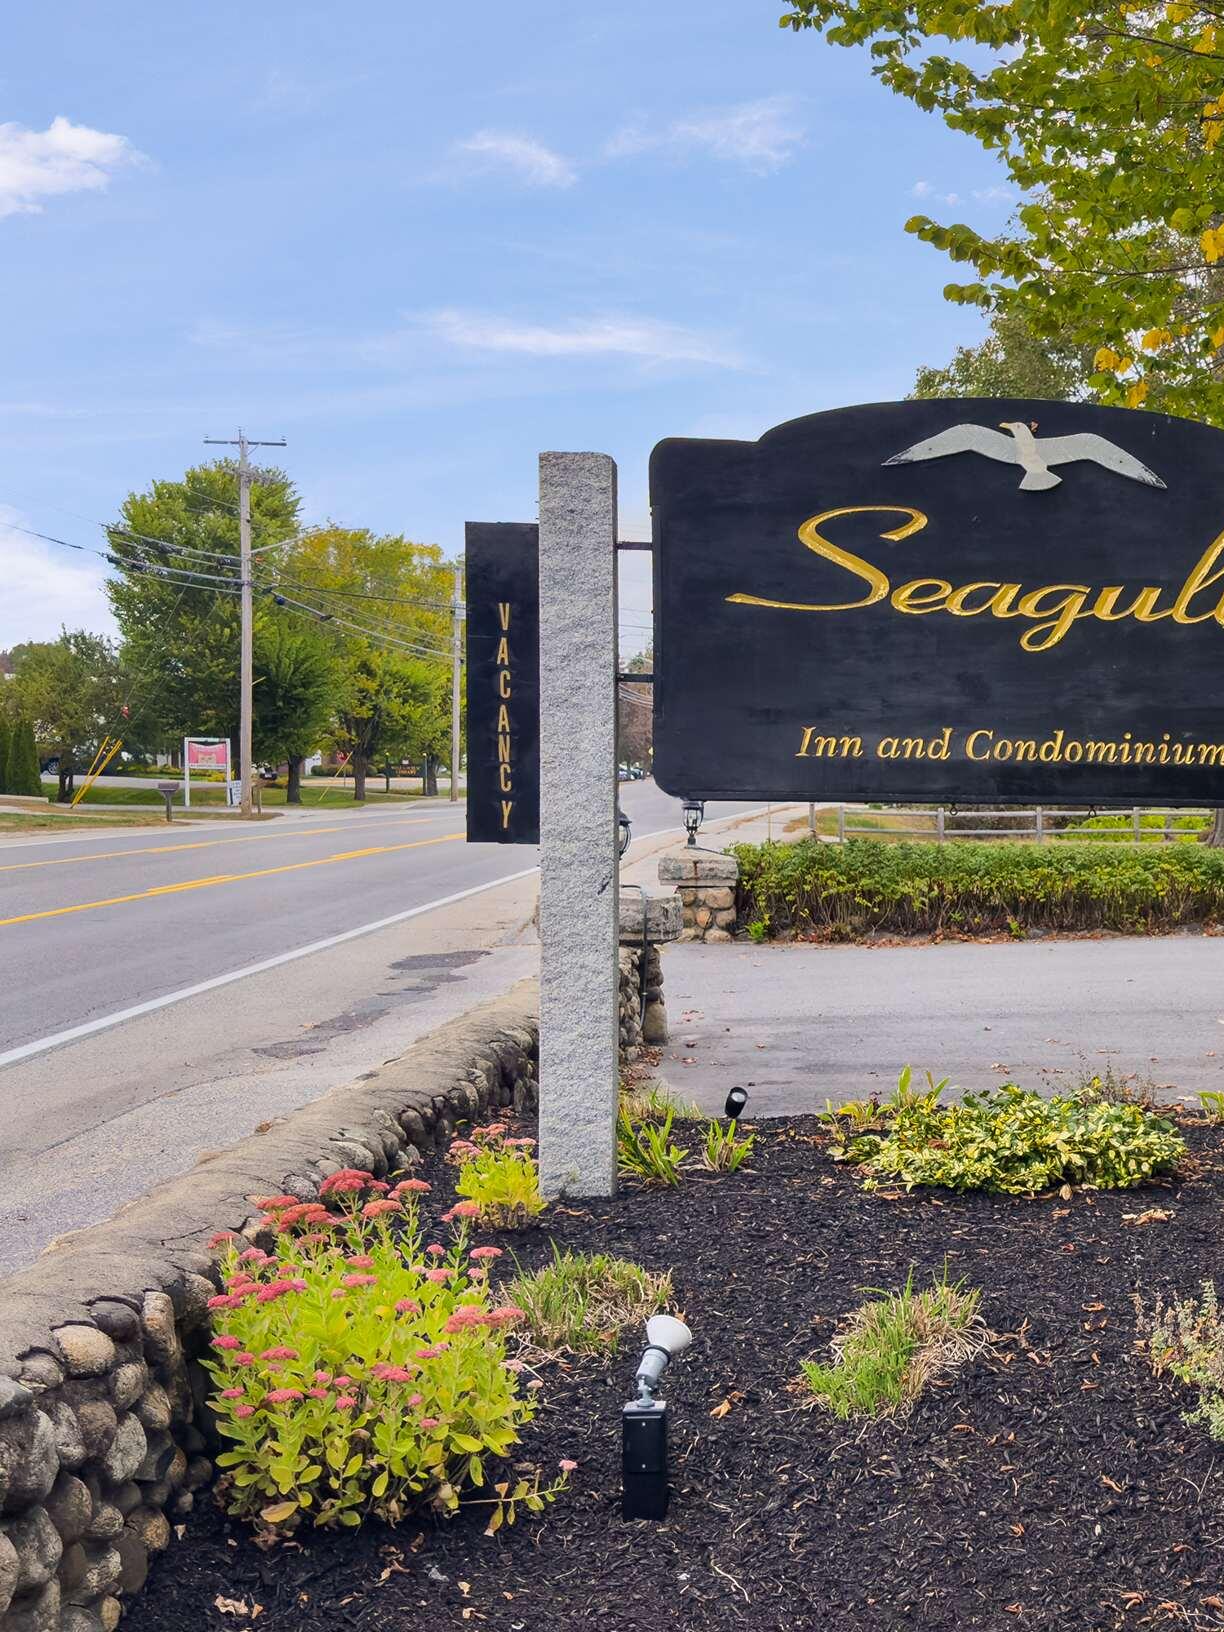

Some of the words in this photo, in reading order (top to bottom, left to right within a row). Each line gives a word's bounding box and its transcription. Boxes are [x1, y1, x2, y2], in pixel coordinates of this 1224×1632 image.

[496, 602, 513, 829] VACANCY
[795, 726, 864, 759] Inn
[876, 728, 954, 760] and
